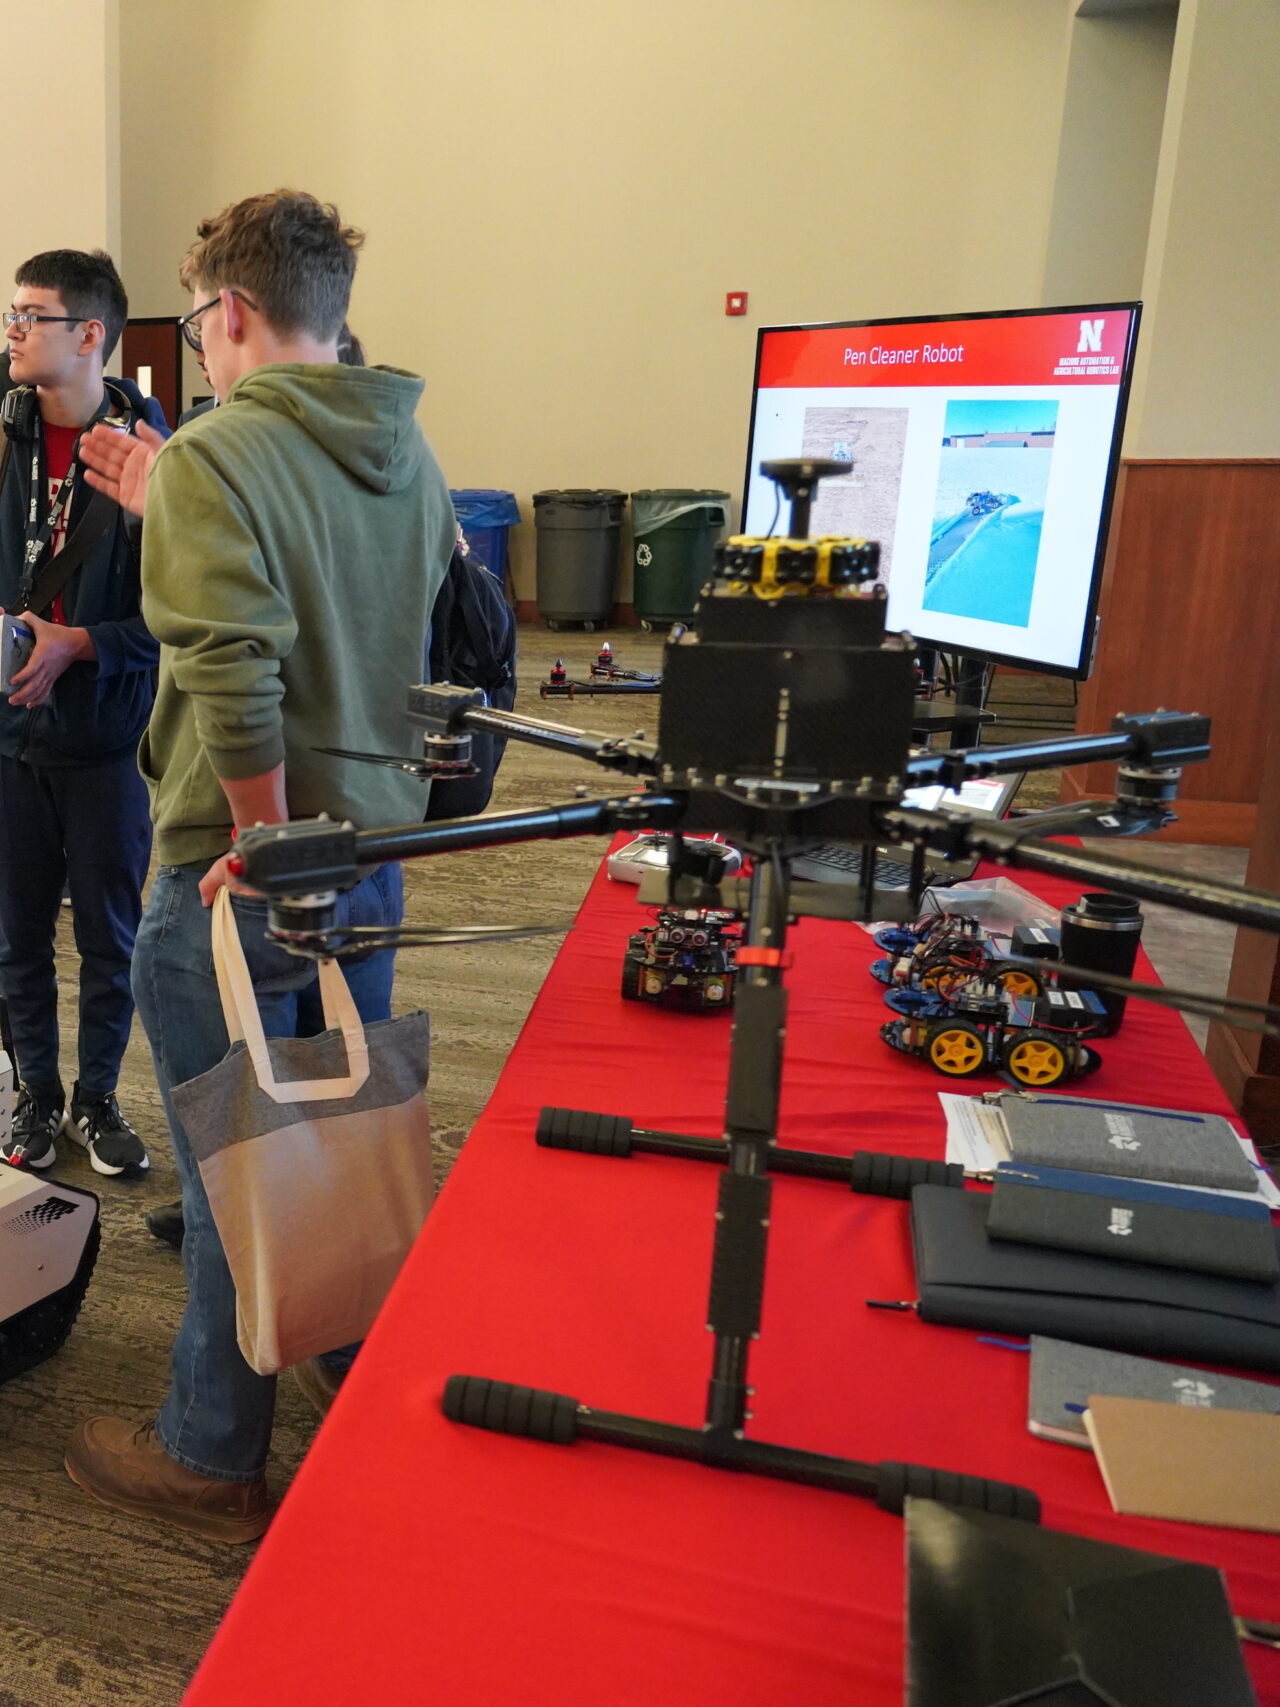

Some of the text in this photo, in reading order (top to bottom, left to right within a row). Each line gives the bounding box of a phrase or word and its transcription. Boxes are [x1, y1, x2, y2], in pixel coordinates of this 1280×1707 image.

[1077, 319, 1105, 352] N
[843, 343, 964, 366] Pen Cleaner Robot
